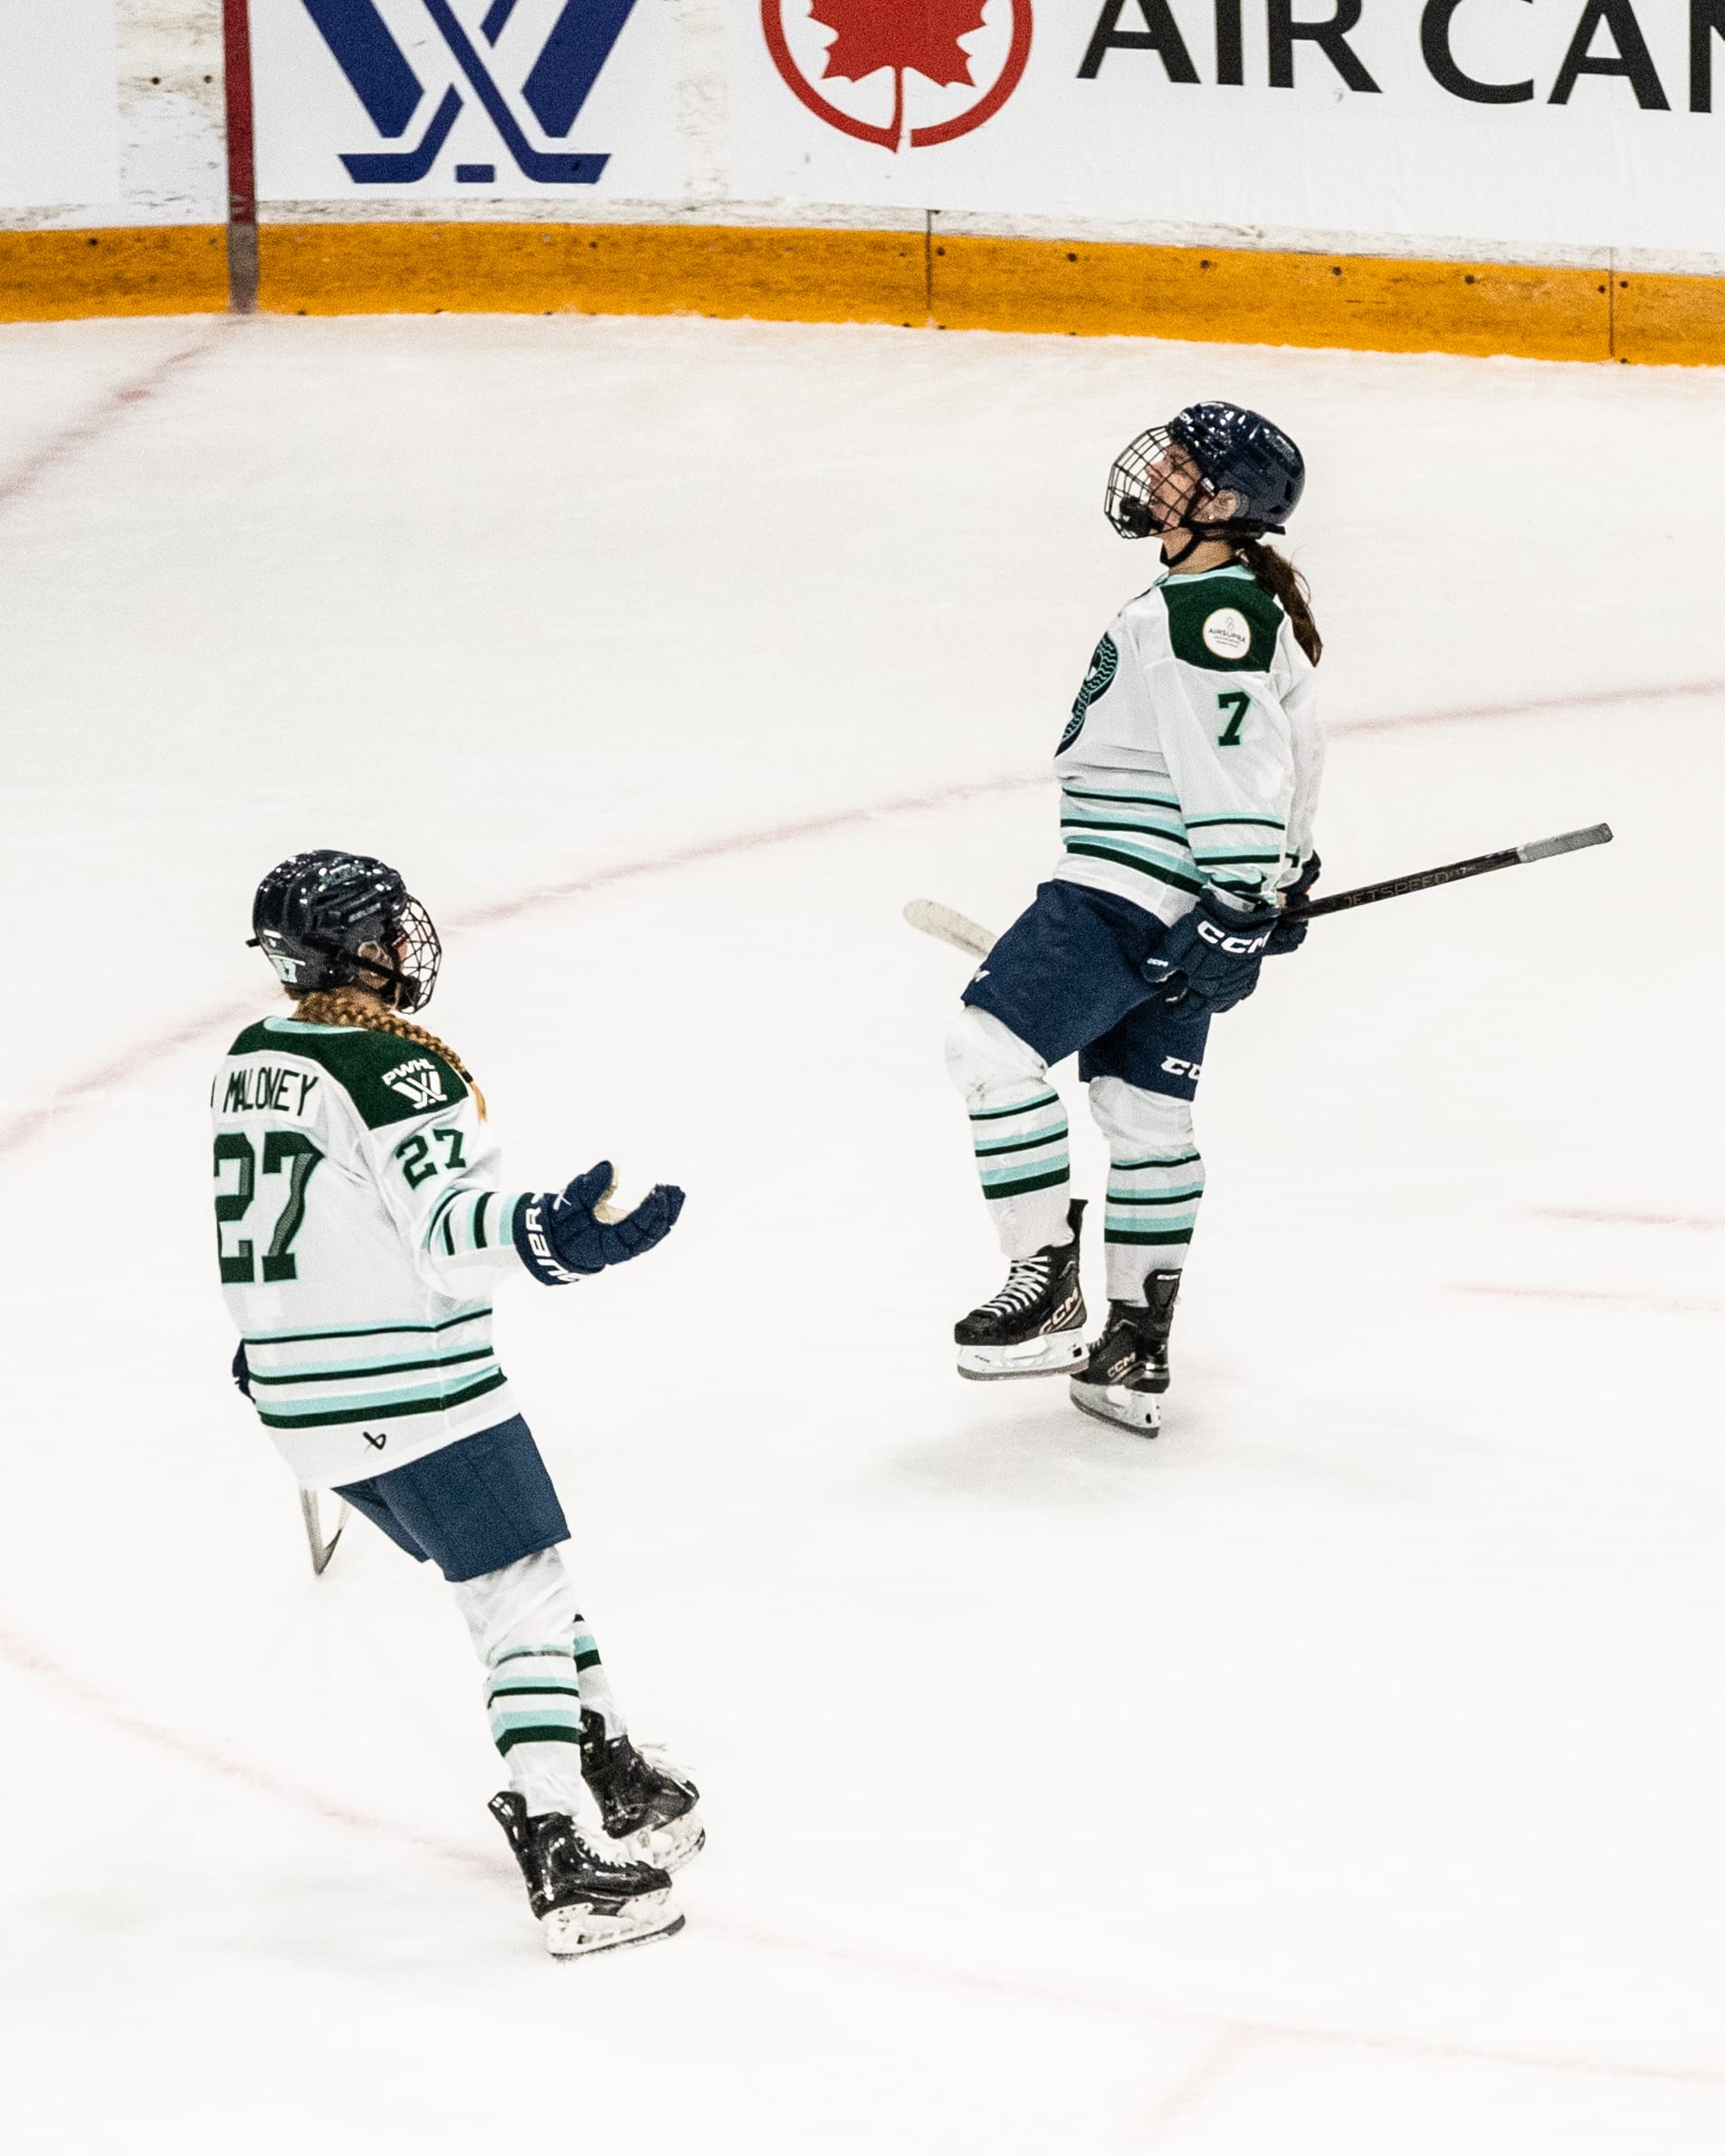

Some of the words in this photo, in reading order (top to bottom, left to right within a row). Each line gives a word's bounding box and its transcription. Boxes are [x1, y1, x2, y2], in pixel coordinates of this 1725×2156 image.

[1076, 0, 1383, 93] AIR
[1216, 689, 1251, 749] 7
[381, 1058, 435, 1086] PWHL
[396, 1128, 466, 1190] 27
[214, 1130, 324, 1284] 27
